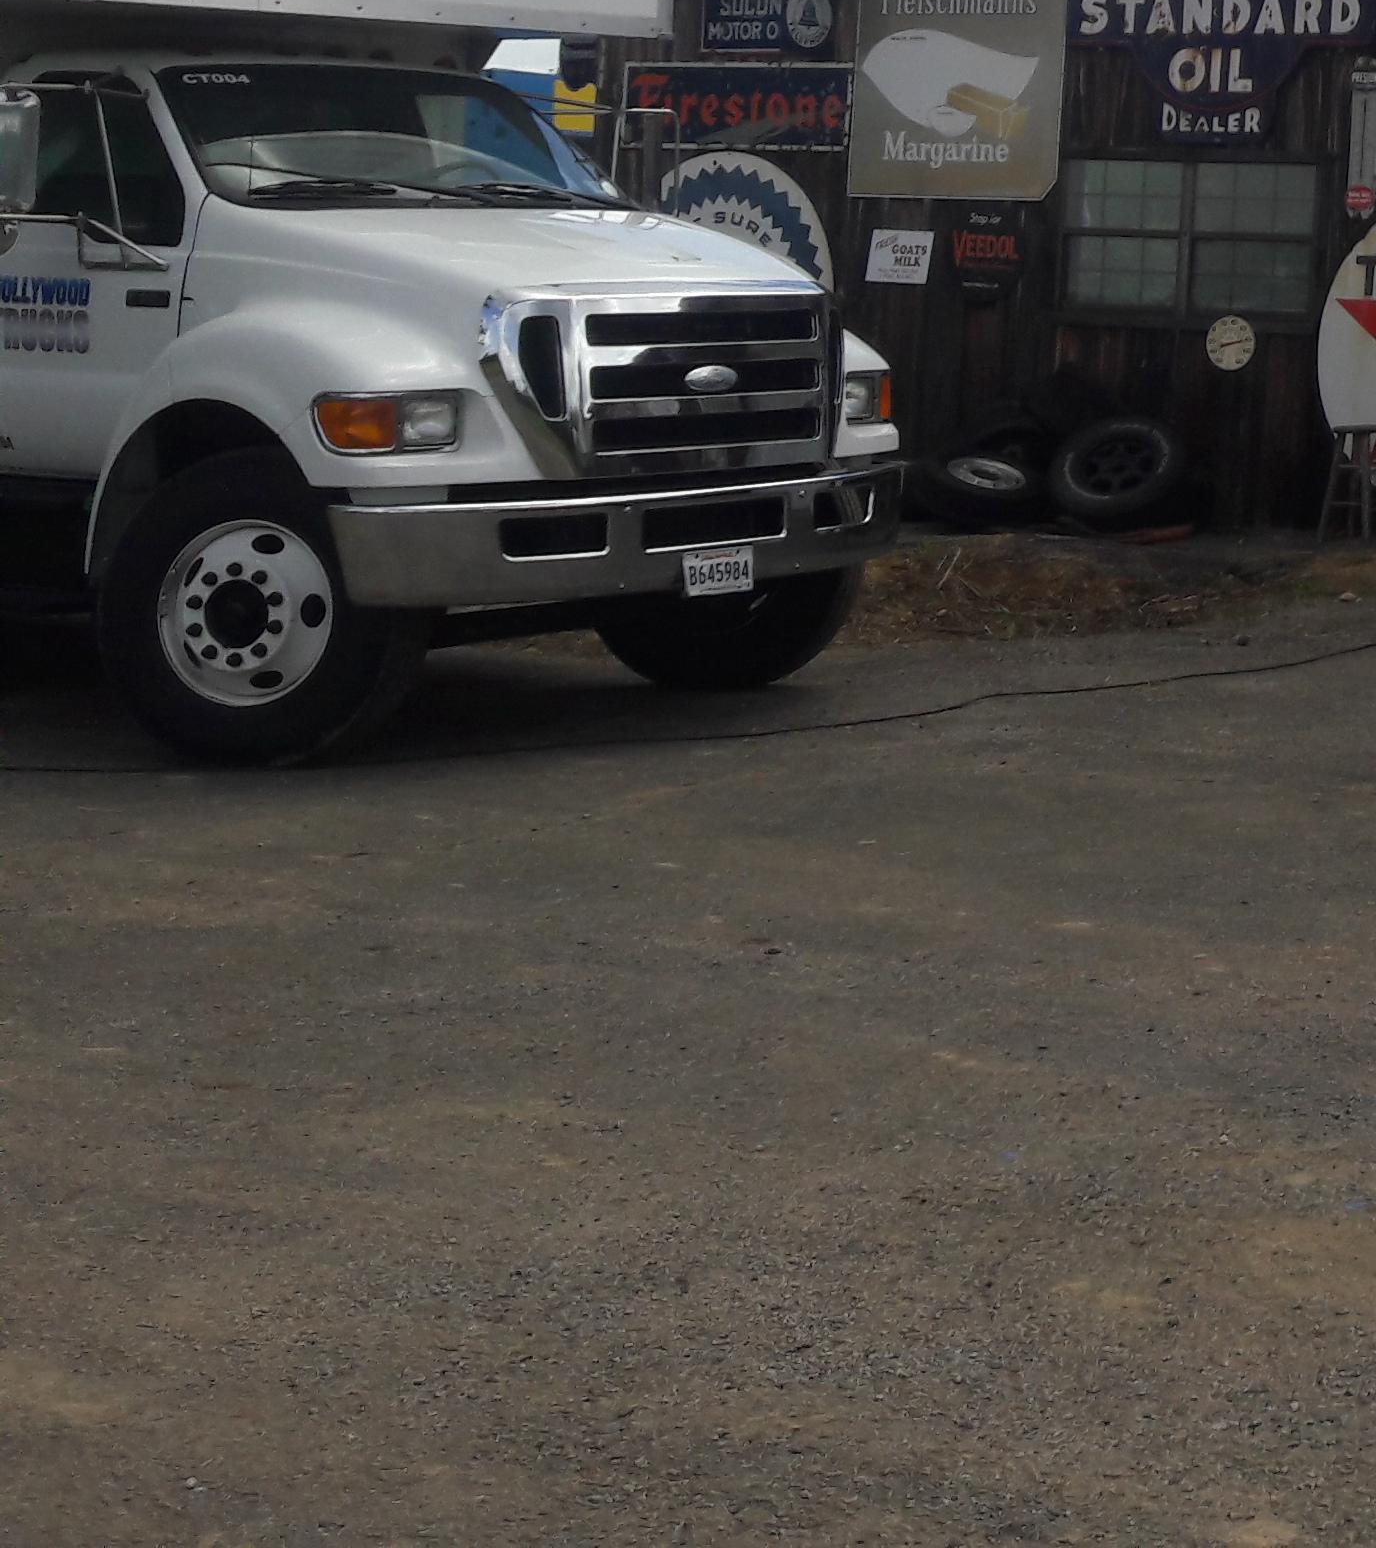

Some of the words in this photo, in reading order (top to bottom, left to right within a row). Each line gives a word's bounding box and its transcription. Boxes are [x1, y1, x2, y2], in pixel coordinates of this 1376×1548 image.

[708, 20, 761, 41] MOTOR
[1168, 47, 1252, 93] OIL
[631, 73, 845, 128] Firestone
[1162, 101, 1262, 133] DEALER
[882, 131, 1010, 169] Margarine
[714, 211, 772, 248] SURE
[893, 256, 921, 267] MILK
[953, 229, 1020, 268] VEEDOL
[0, 276, 91, 306] OLLYWOOD
[689, 560, 749, 586] B645984
